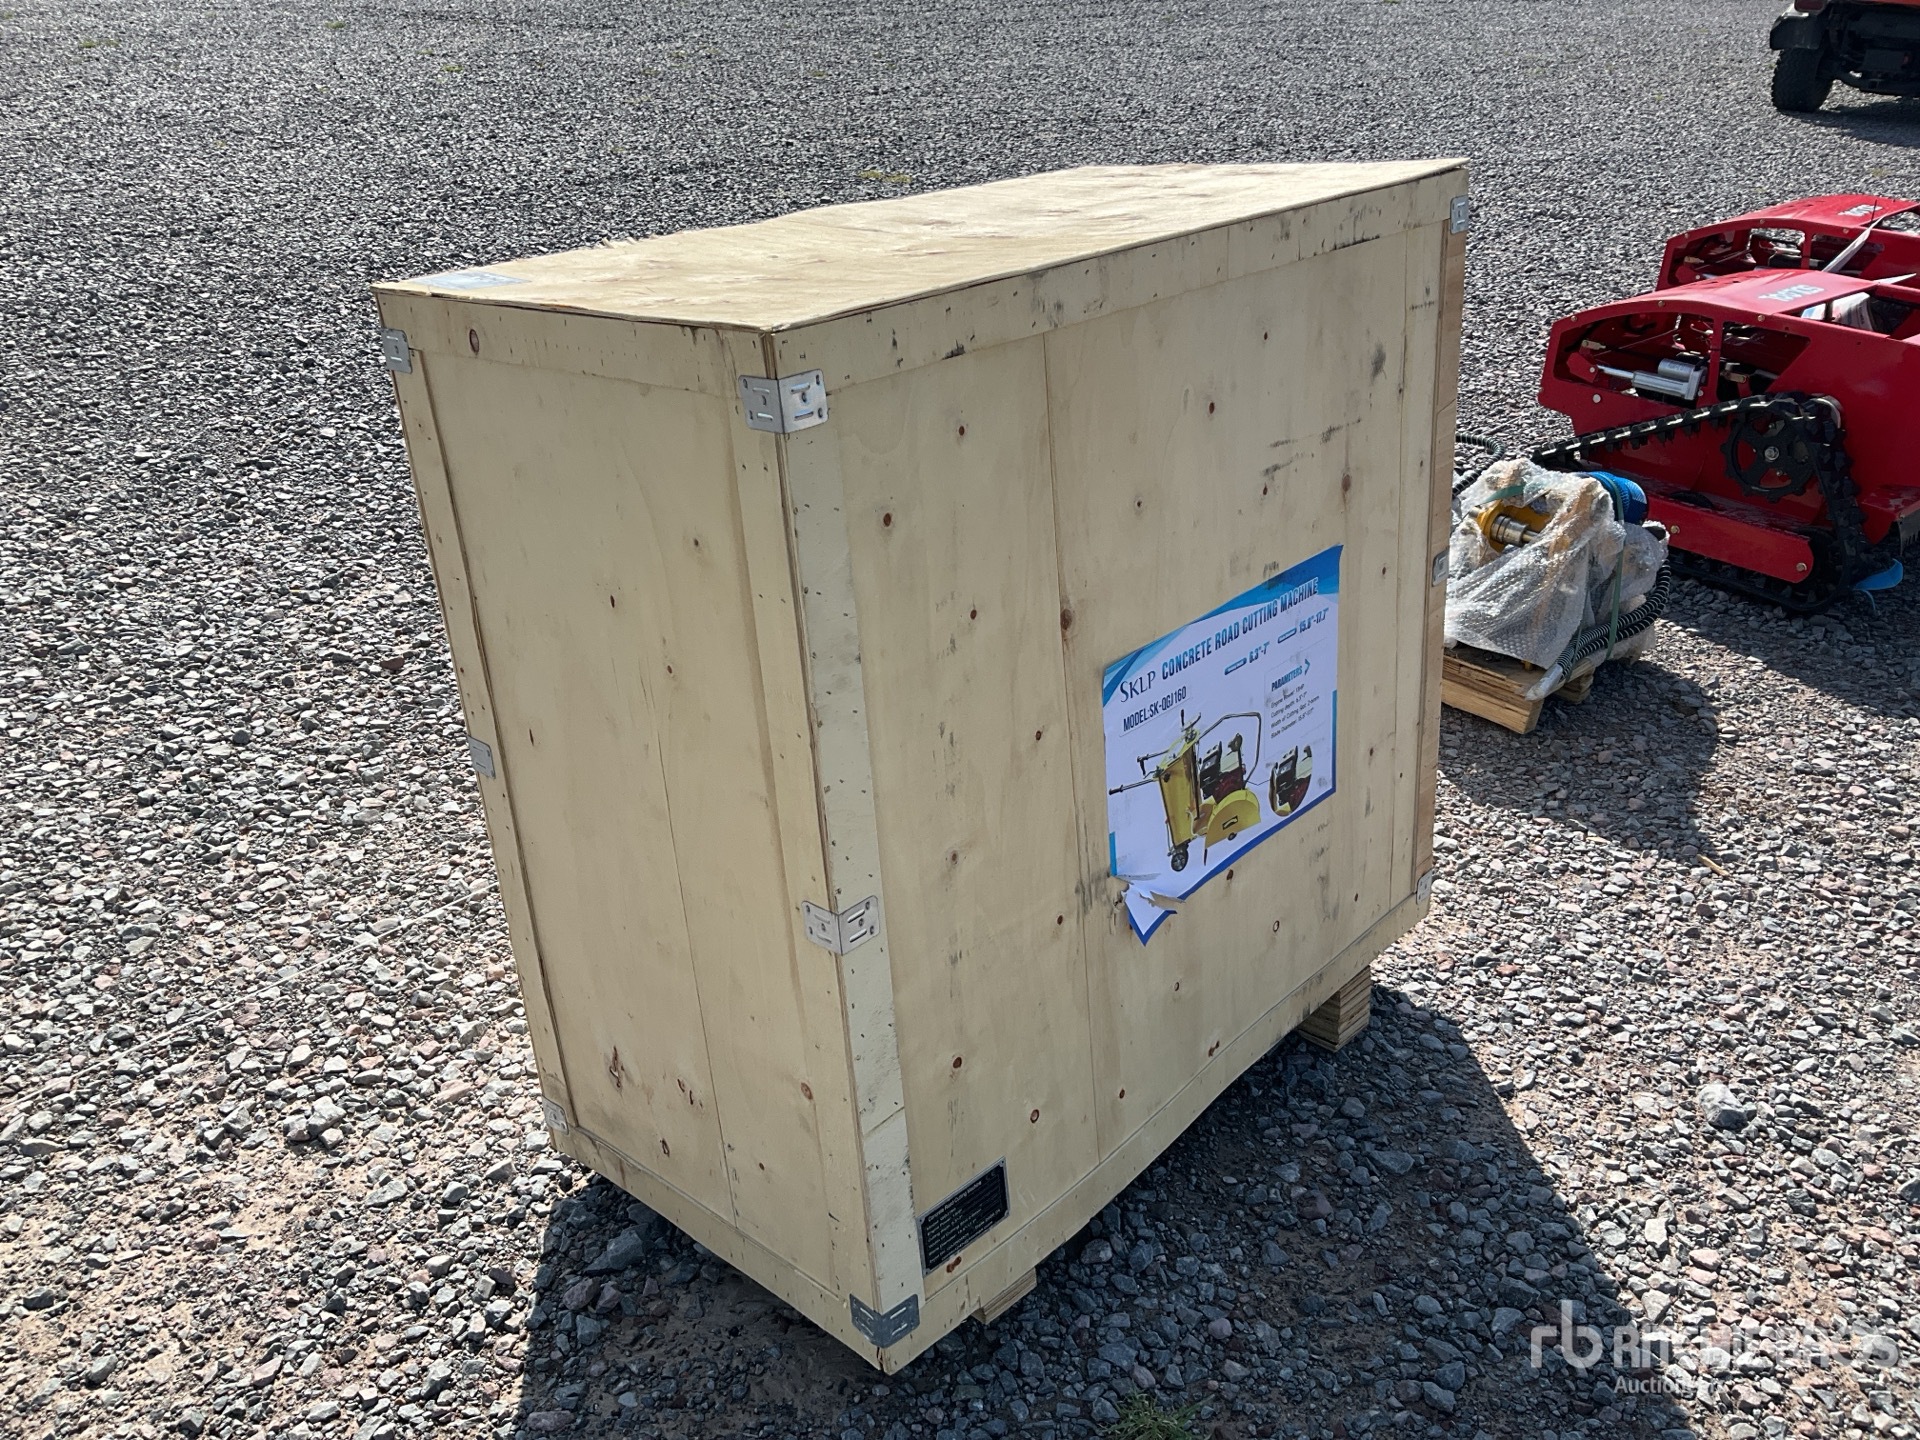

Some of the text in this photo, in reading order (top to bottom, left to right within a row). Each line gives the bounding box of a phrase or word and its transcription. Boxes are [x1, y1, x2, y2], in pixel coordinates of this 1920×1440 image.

[1119, 576, 1319, 703] SKLP CONCRETE ROAD CUTTING MACHINE
[1271, 665, 1303, 691] PARAMETERS
